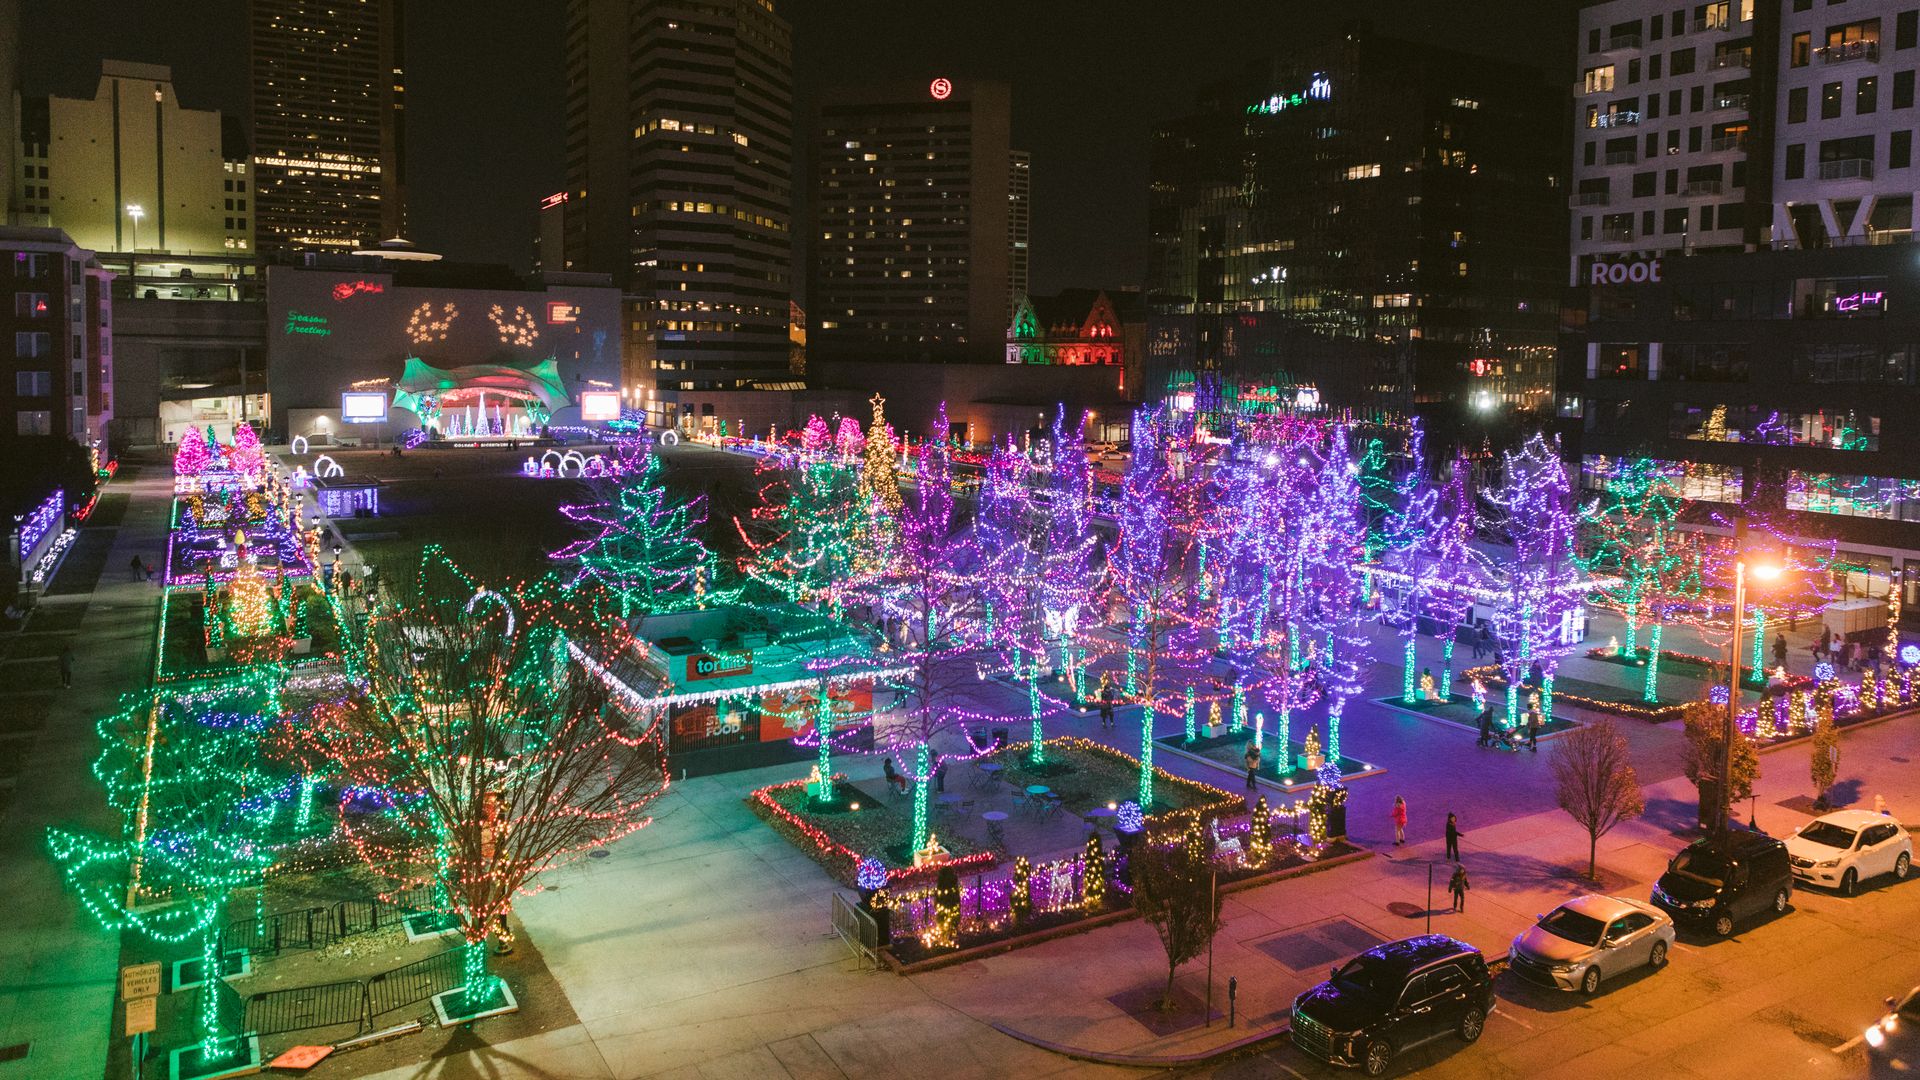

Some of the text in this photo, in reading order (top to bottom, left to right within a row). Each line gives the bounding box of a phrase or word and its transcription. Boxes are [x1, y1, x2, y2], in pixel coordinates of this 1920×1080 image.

[706, 724, 740, 737] FOOD
[125, 967, 160, 977] AUTHORIZED
[127, 976, 157, 987] VEHICLES
[133, 985, 150, 994] ONLY
